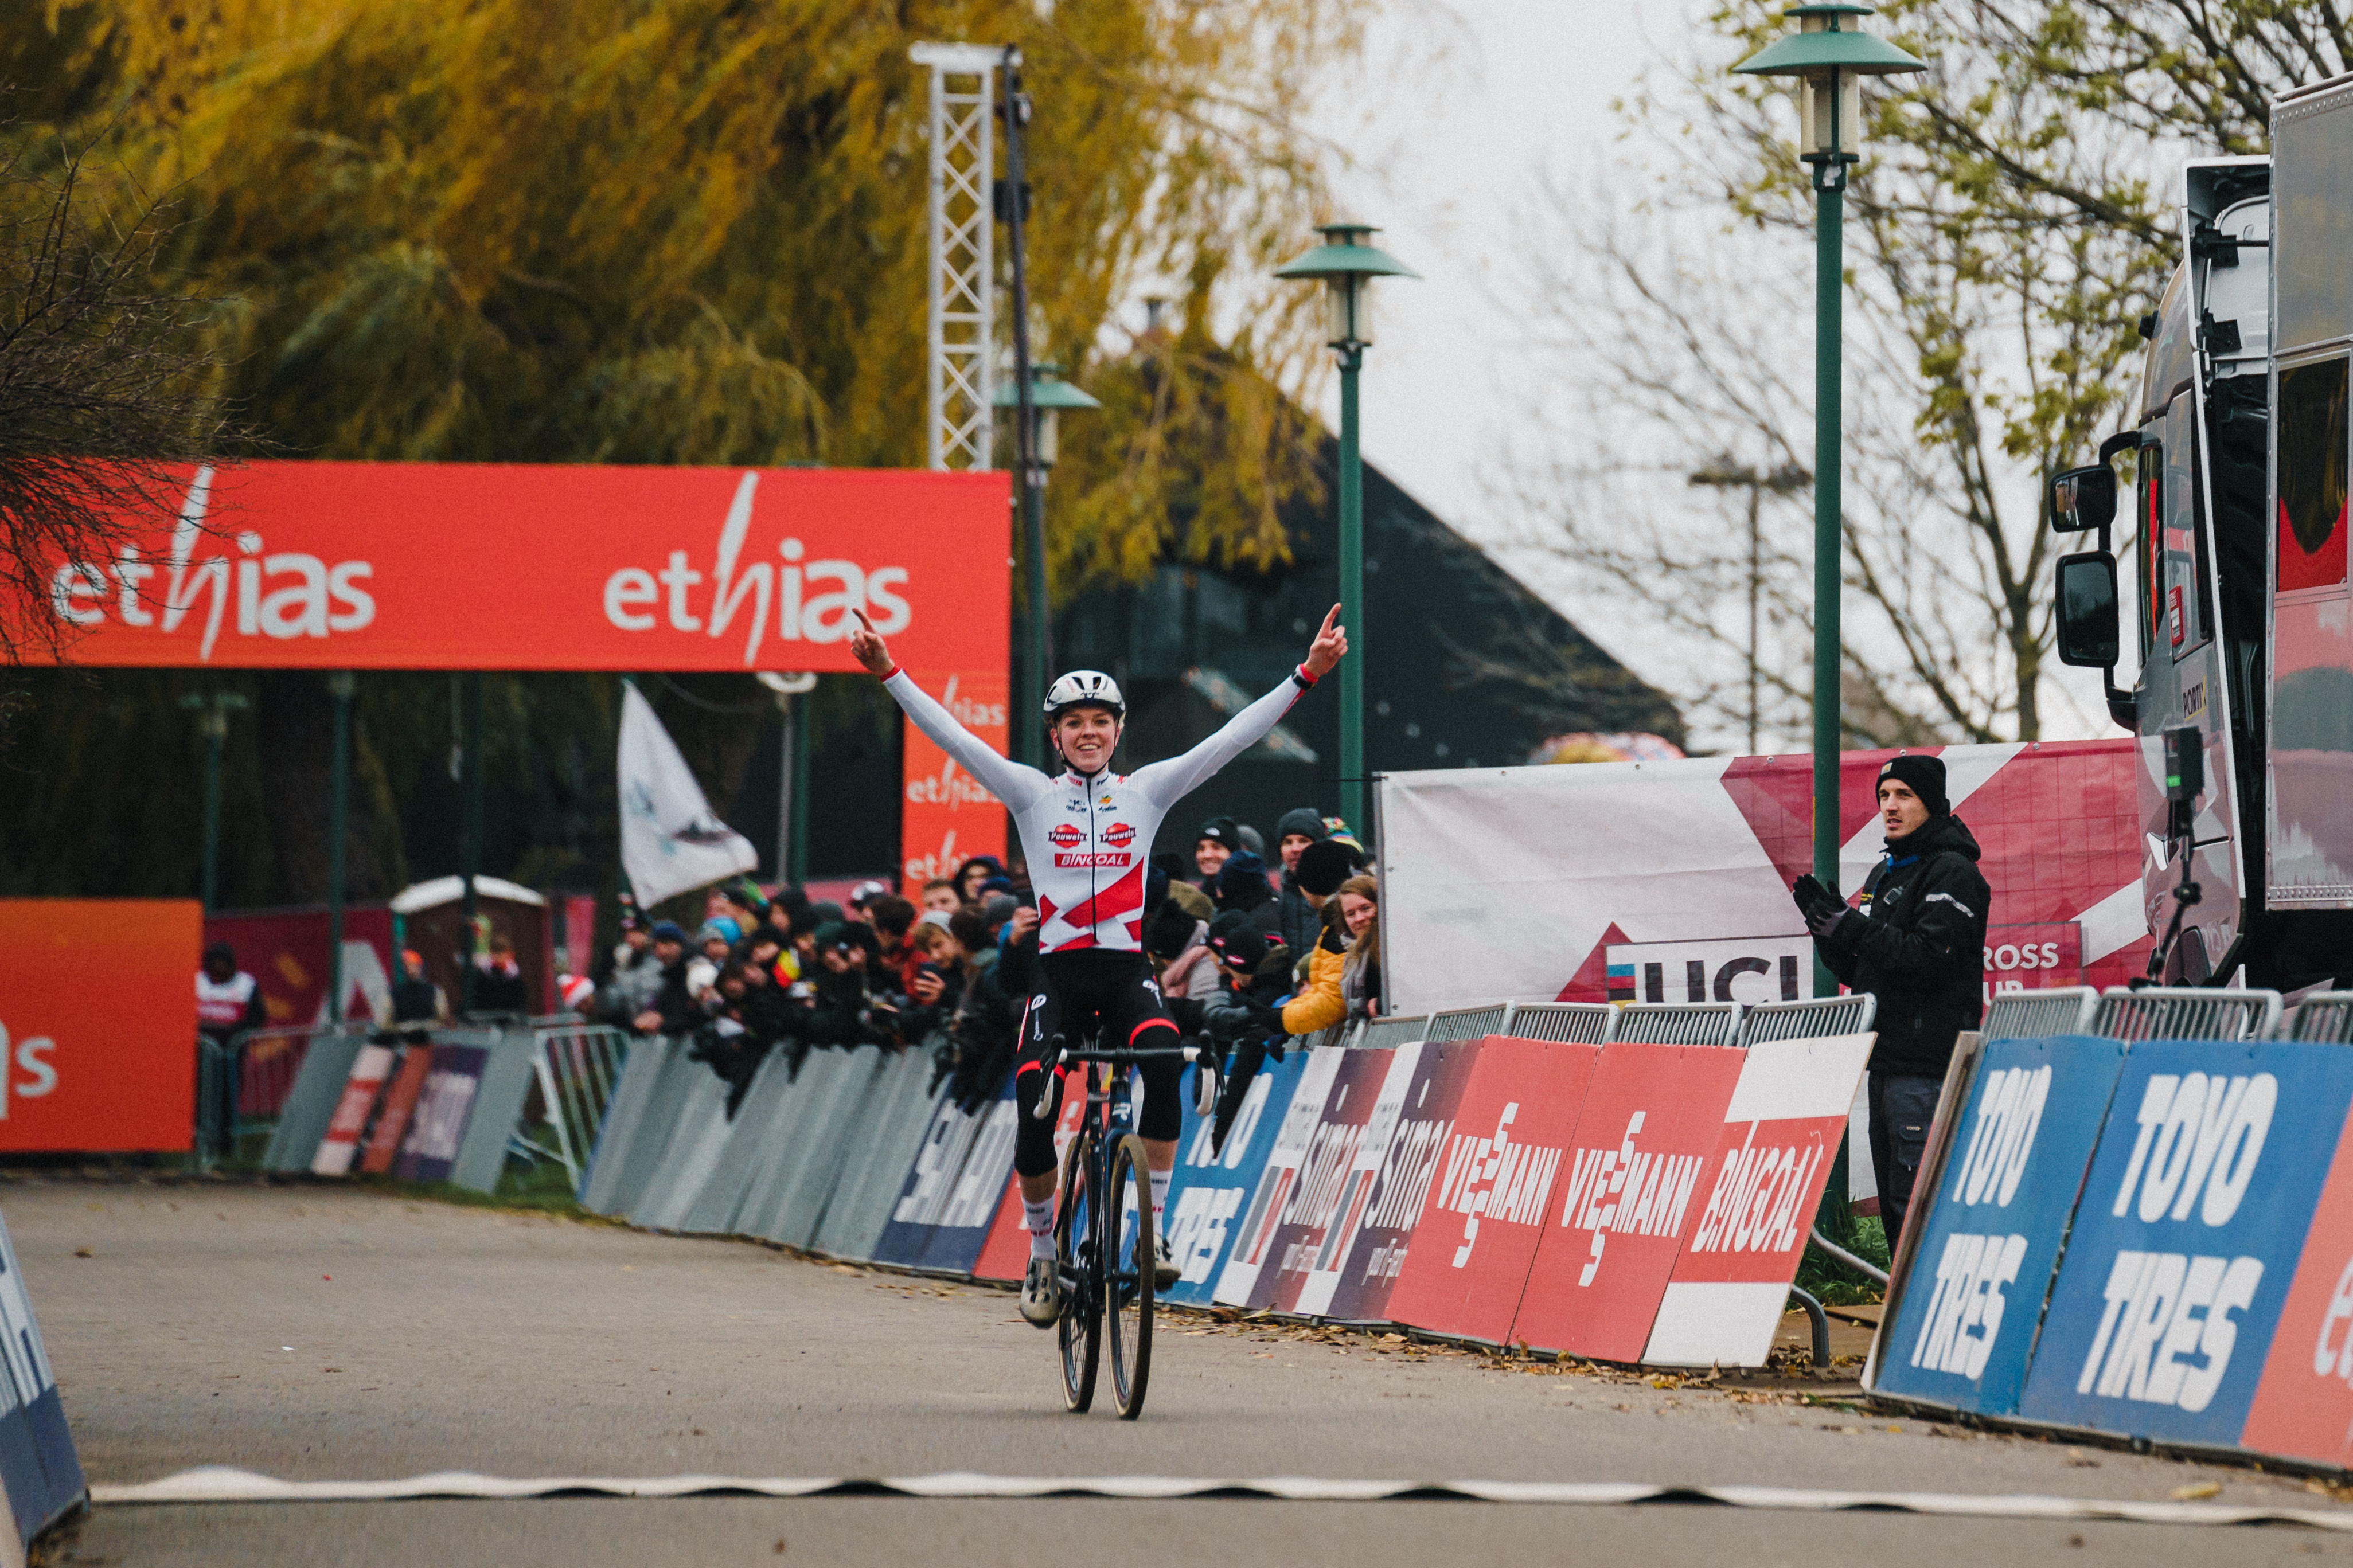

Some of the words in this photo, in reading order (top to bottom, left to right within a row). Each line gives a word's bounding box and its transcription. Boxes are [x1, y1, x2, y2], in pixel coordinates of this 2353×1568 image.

[50, 464, 376, 663] ethias
[604, 470, 911, 667] ethias
[907, 756, 1001, 812] ethia
[1051, 832, 1084, 841] Pauwels
[1103, 830, 1134, 842] Pauwels
[1061, 853, 1123, 866] BINGOAL
[1644, 955, 1799, 1019] UCI
[1691, 1120, 1824, 1253] BINGOAL
[1953, 1065, 2052, 1206] TOYO
[2112, 1072, 2278, 1227] TOYO
[1911, 1233, 2028, 1381] TIRES
[2077, 1250, 2265, 1413] TIRES
